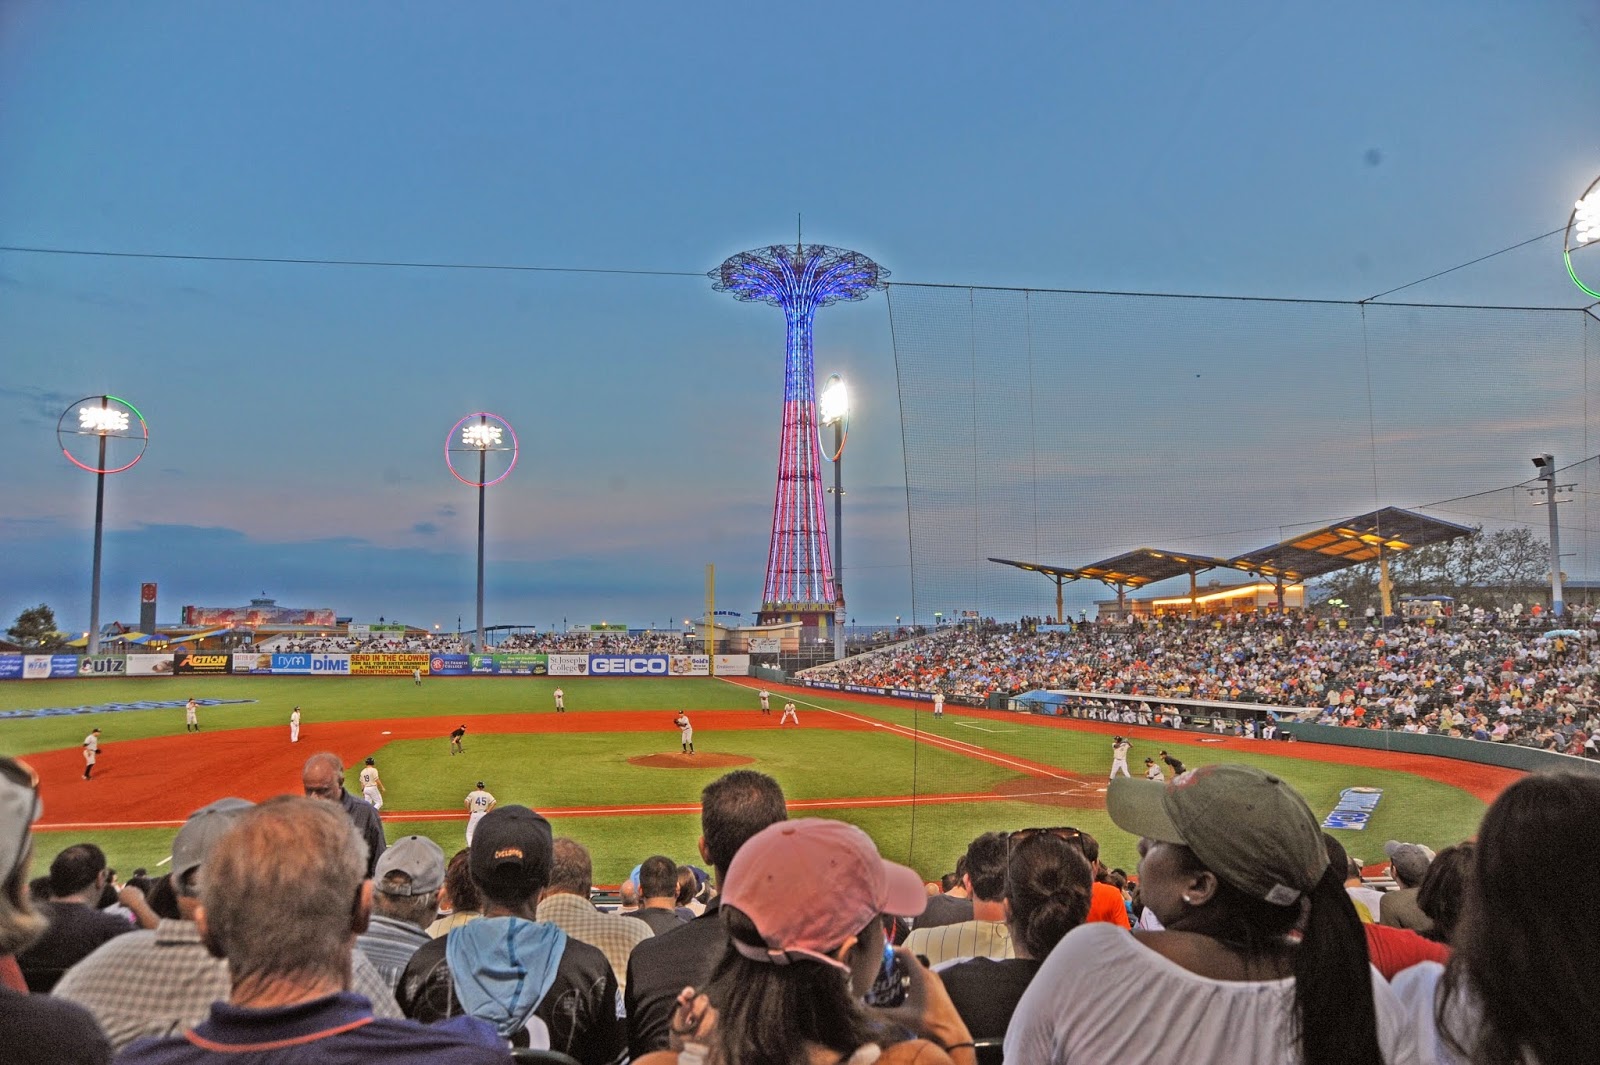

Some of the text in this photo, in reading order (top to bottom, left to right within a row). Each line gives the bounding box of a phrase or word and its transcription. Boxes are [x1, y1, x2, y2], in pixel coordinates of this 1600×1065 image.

[350, 654, 429, 662] SEND IN THE CLOWNS
[94, 657, 124, 672] utz
[550, 663, 578, 673] College
[591, 658, 668, 673] GEICO
[475, 797, 487, 806] 45
